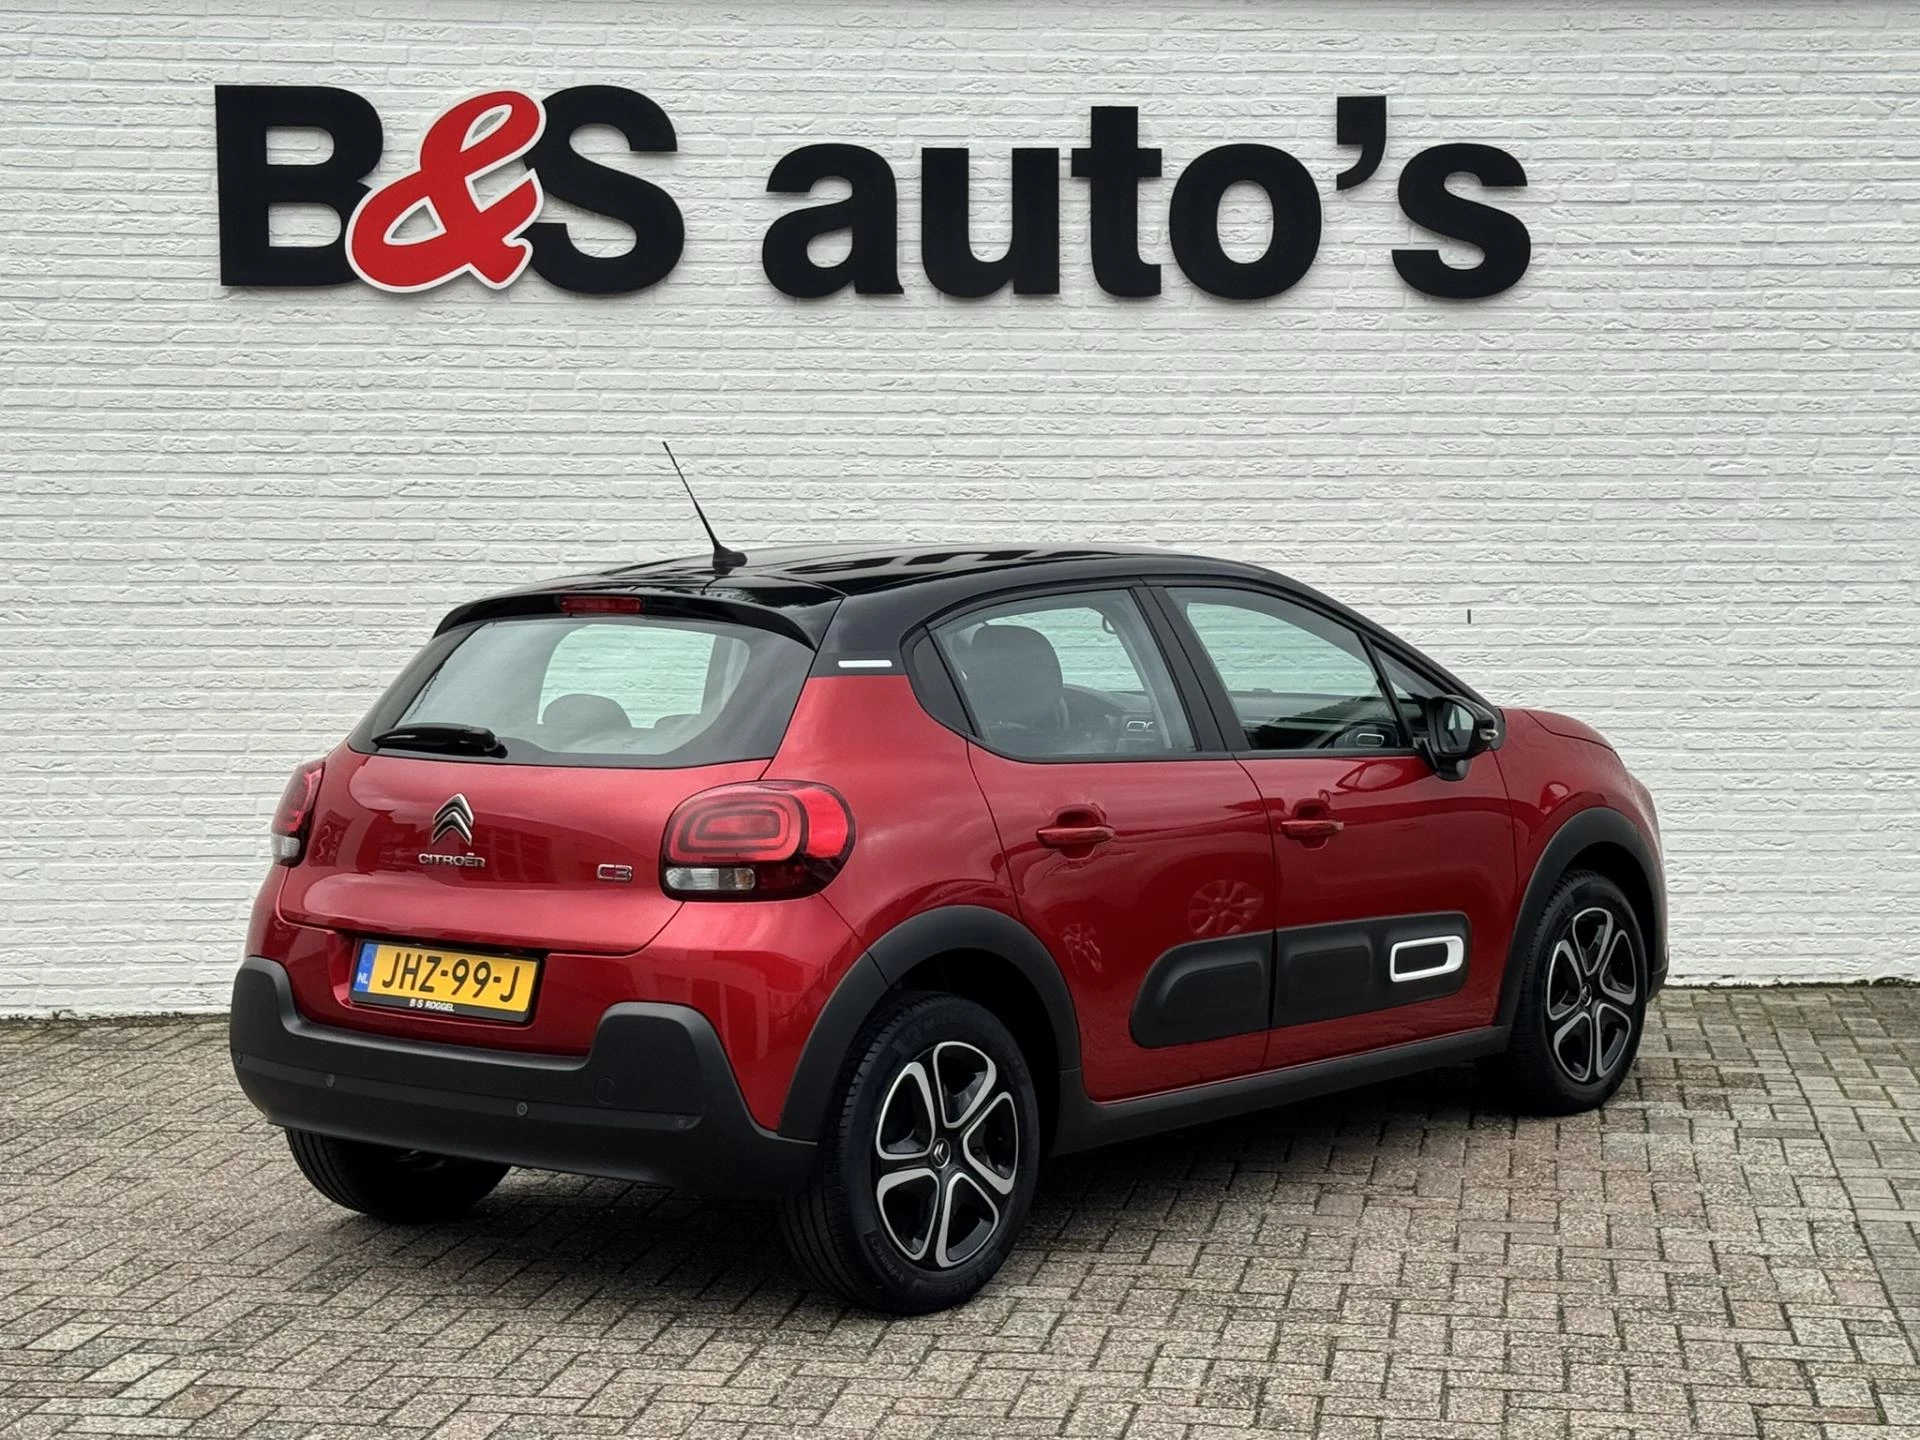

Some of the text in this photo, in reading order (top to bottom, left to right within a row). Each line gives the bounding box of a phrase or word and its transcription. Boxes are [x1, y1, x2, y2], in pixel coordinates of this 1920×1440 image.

[215, 84, 1532, 299] B&S auto's
[418, 852, 486, 868] CITROËN
[597, 863, 633, 882] C3
[357, 973, 369, 985] NL
[381, 951, 521, 1003] JHZ-99-J
[425, 1000, 456, 1013] ROGGEL
